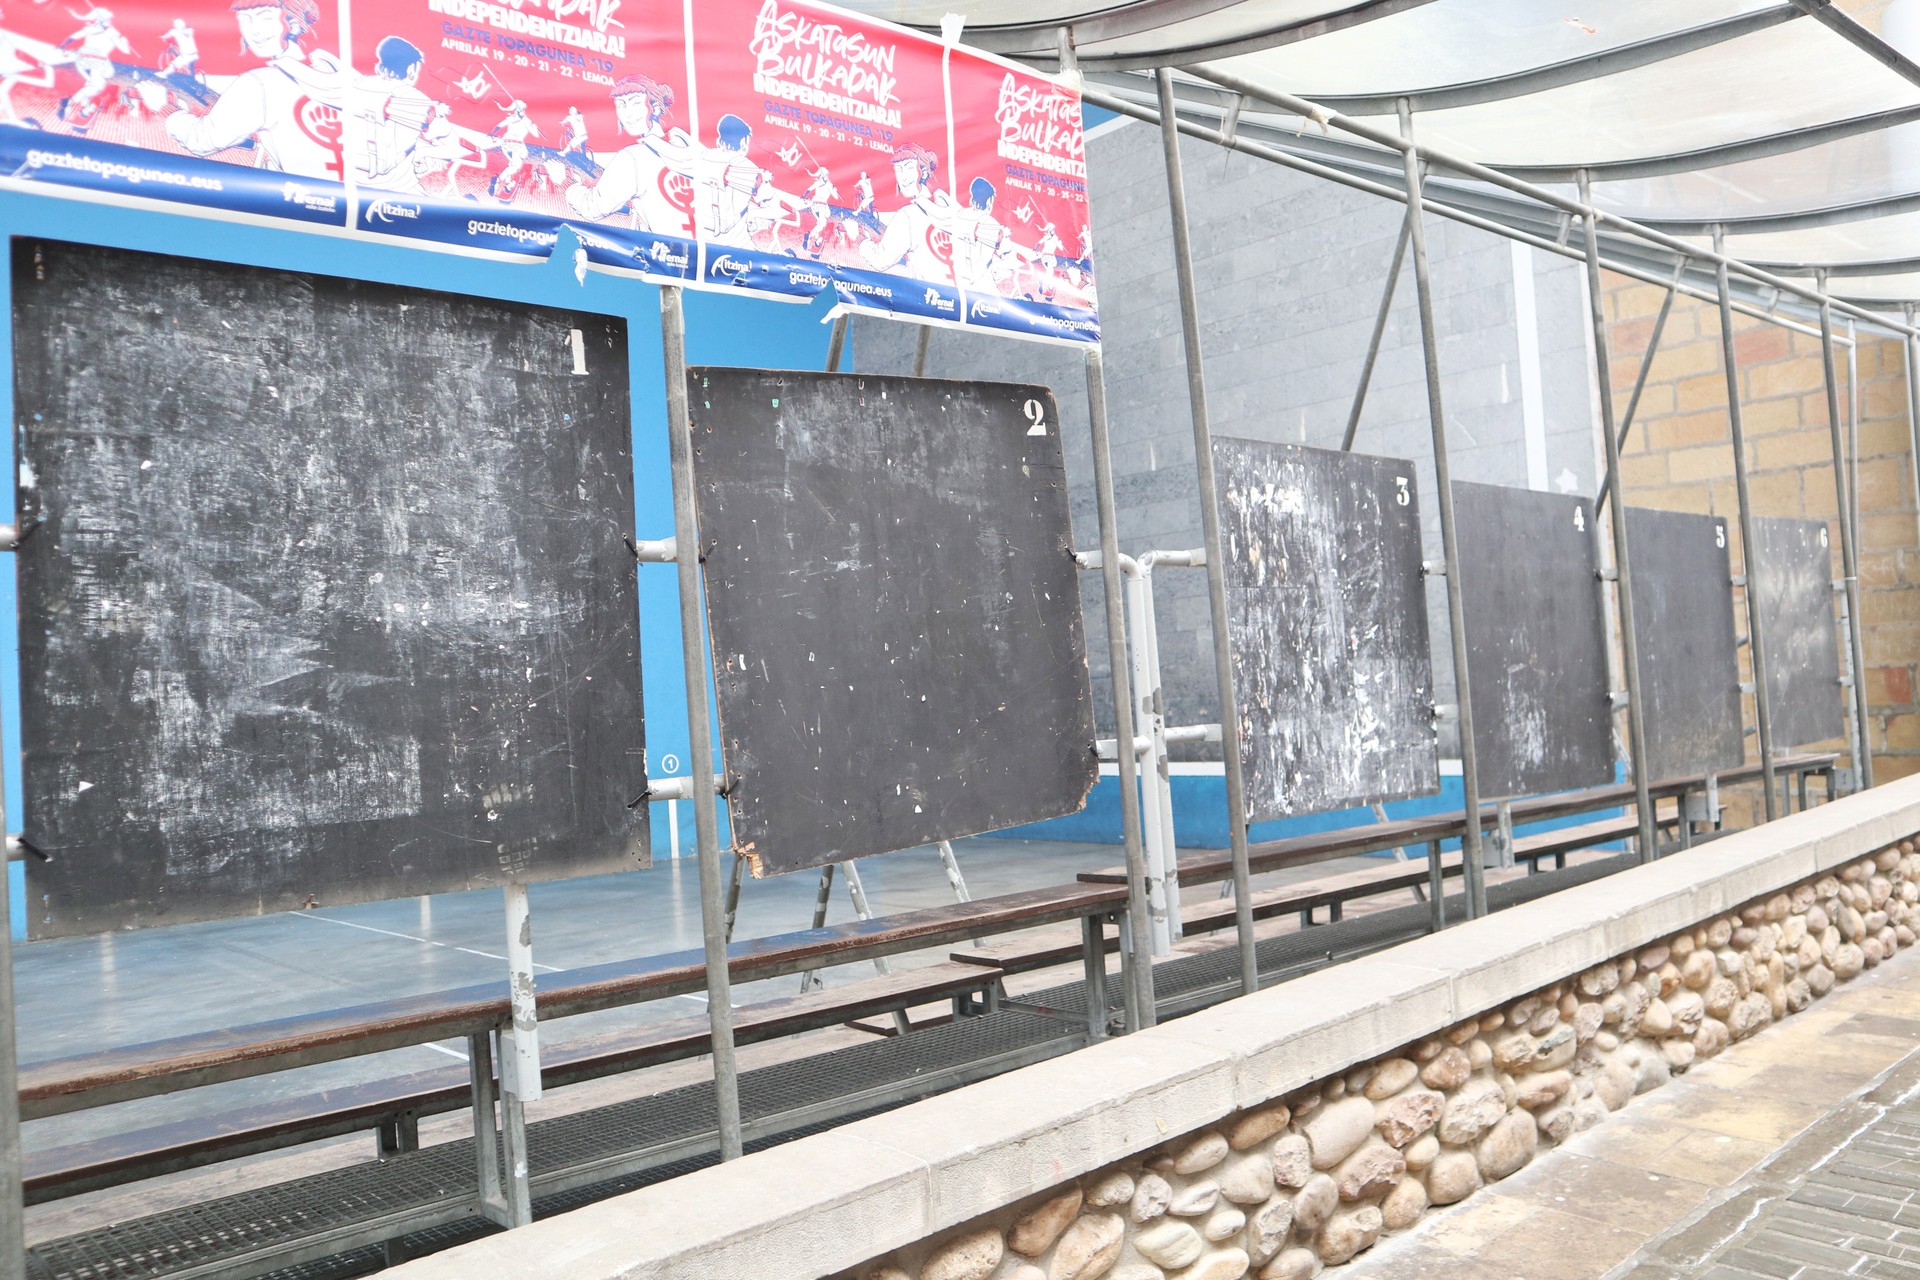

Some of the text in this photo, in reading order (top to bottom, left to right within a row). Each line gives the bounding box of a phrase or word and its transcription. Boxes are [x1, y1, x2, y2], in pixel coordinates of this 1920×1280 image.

[441, 37, 616, 87] APIRILAK 19 20 21 22 LEMOA
[442, 21, 491, 44] GAZTE
[497, 33, 586, 67] TOPAGUNEA
[753, 73, 901, 129] INDEPENDENTZIARA!
[764, 100, 802, 119] GAZTE
[806, 110, 872, 137] TOPAGUNEA
[764, 114, 894, 154] APIRILAK 19 20 21 22 LEMOA
[27, 149, 223, 191] gaztetopagunea.eus
[1005, 164, 1033, 180] GAZTE
[1005, 177, 1032, 191] APIRILAK
[1034, 184, 1041, 193] 19
[365, 198, 421, 223] Aitzina!
[564, 328, 589, 375] 1
[1024, 398, 1047, 436] 2
[1396, 476, 1410, 506] 3
[1573, 505, 1585, 532] 4
[1716, 525, 1725, 548] 5
[1820, 527, 1828, 548] 6
